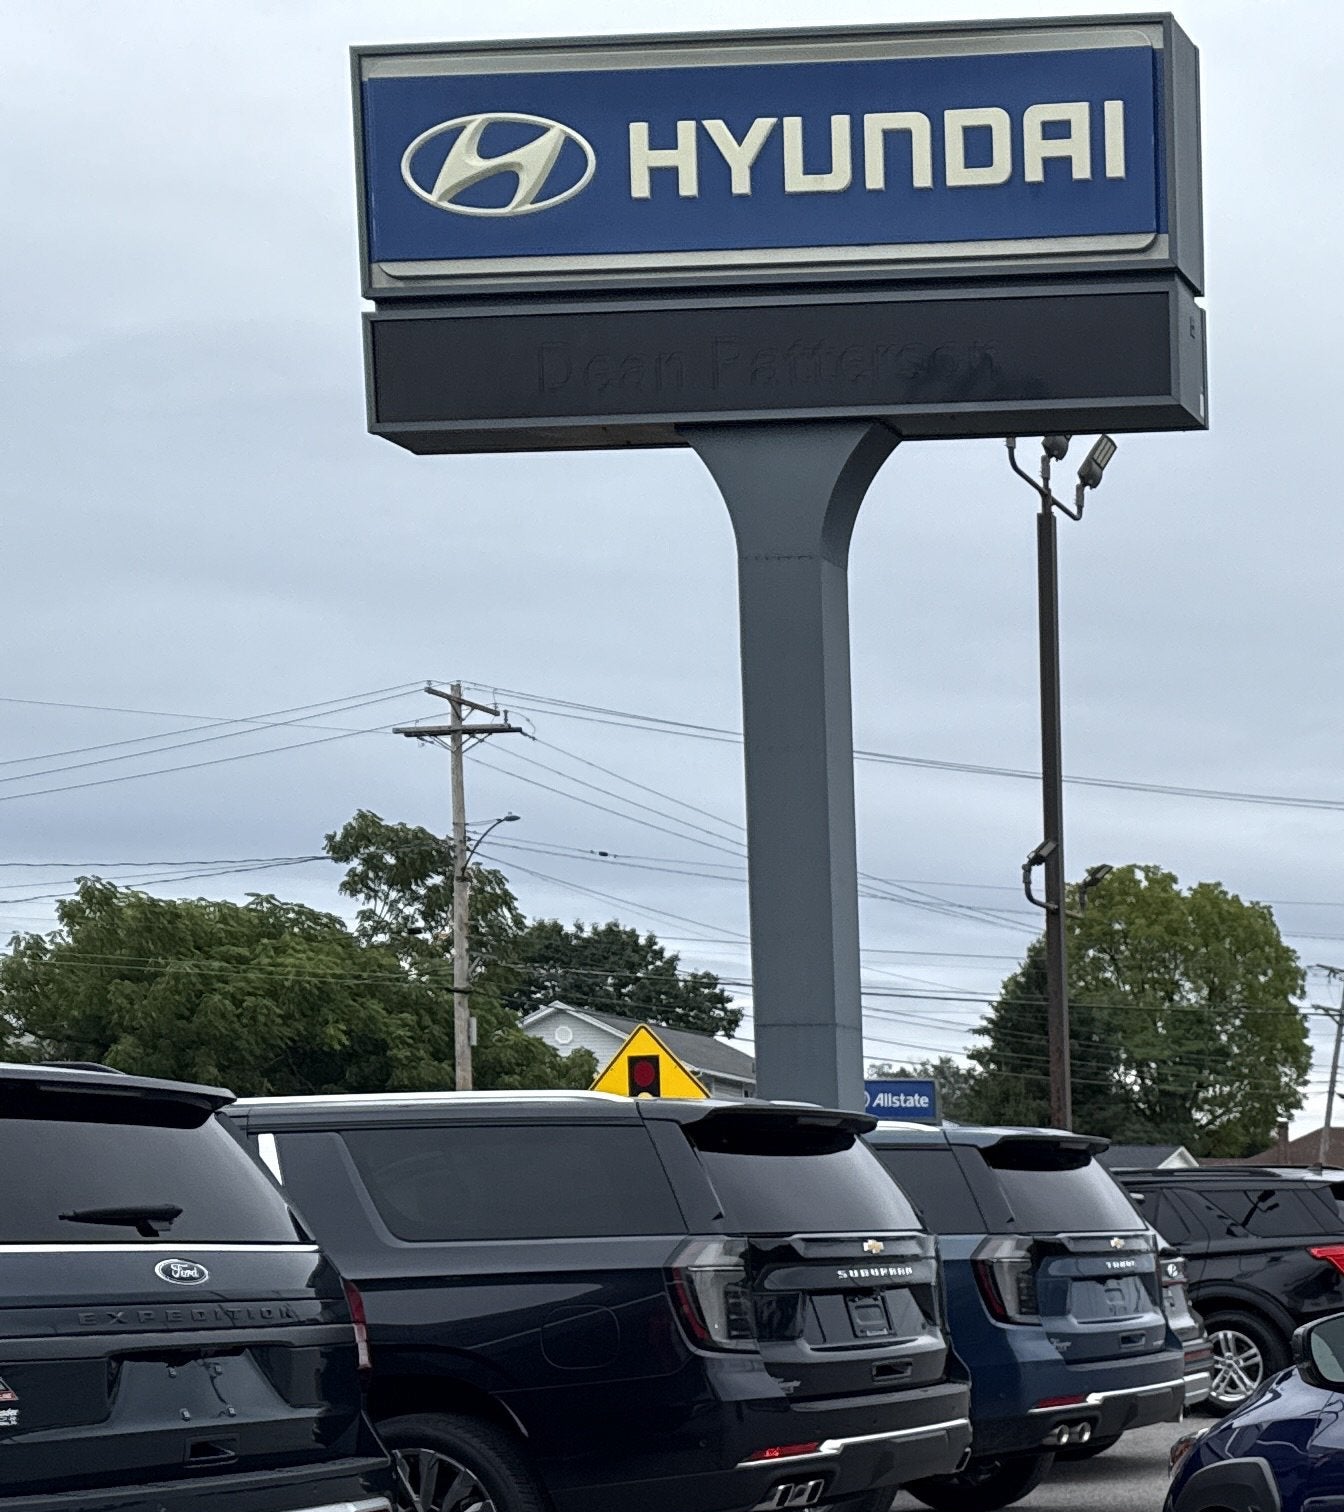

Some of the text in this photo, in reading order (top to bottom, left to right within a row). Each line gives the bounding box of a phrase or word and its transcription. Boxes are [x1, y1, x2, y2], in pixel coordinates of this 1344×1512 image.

[628, 99, 1126, 199] HYUNDAI
[872, 1092, 930, 1108] Allstate
[836, 1266, 913, 1279] SUBURBAN
[77, 1304, 298, 1326] EXPEDITION
